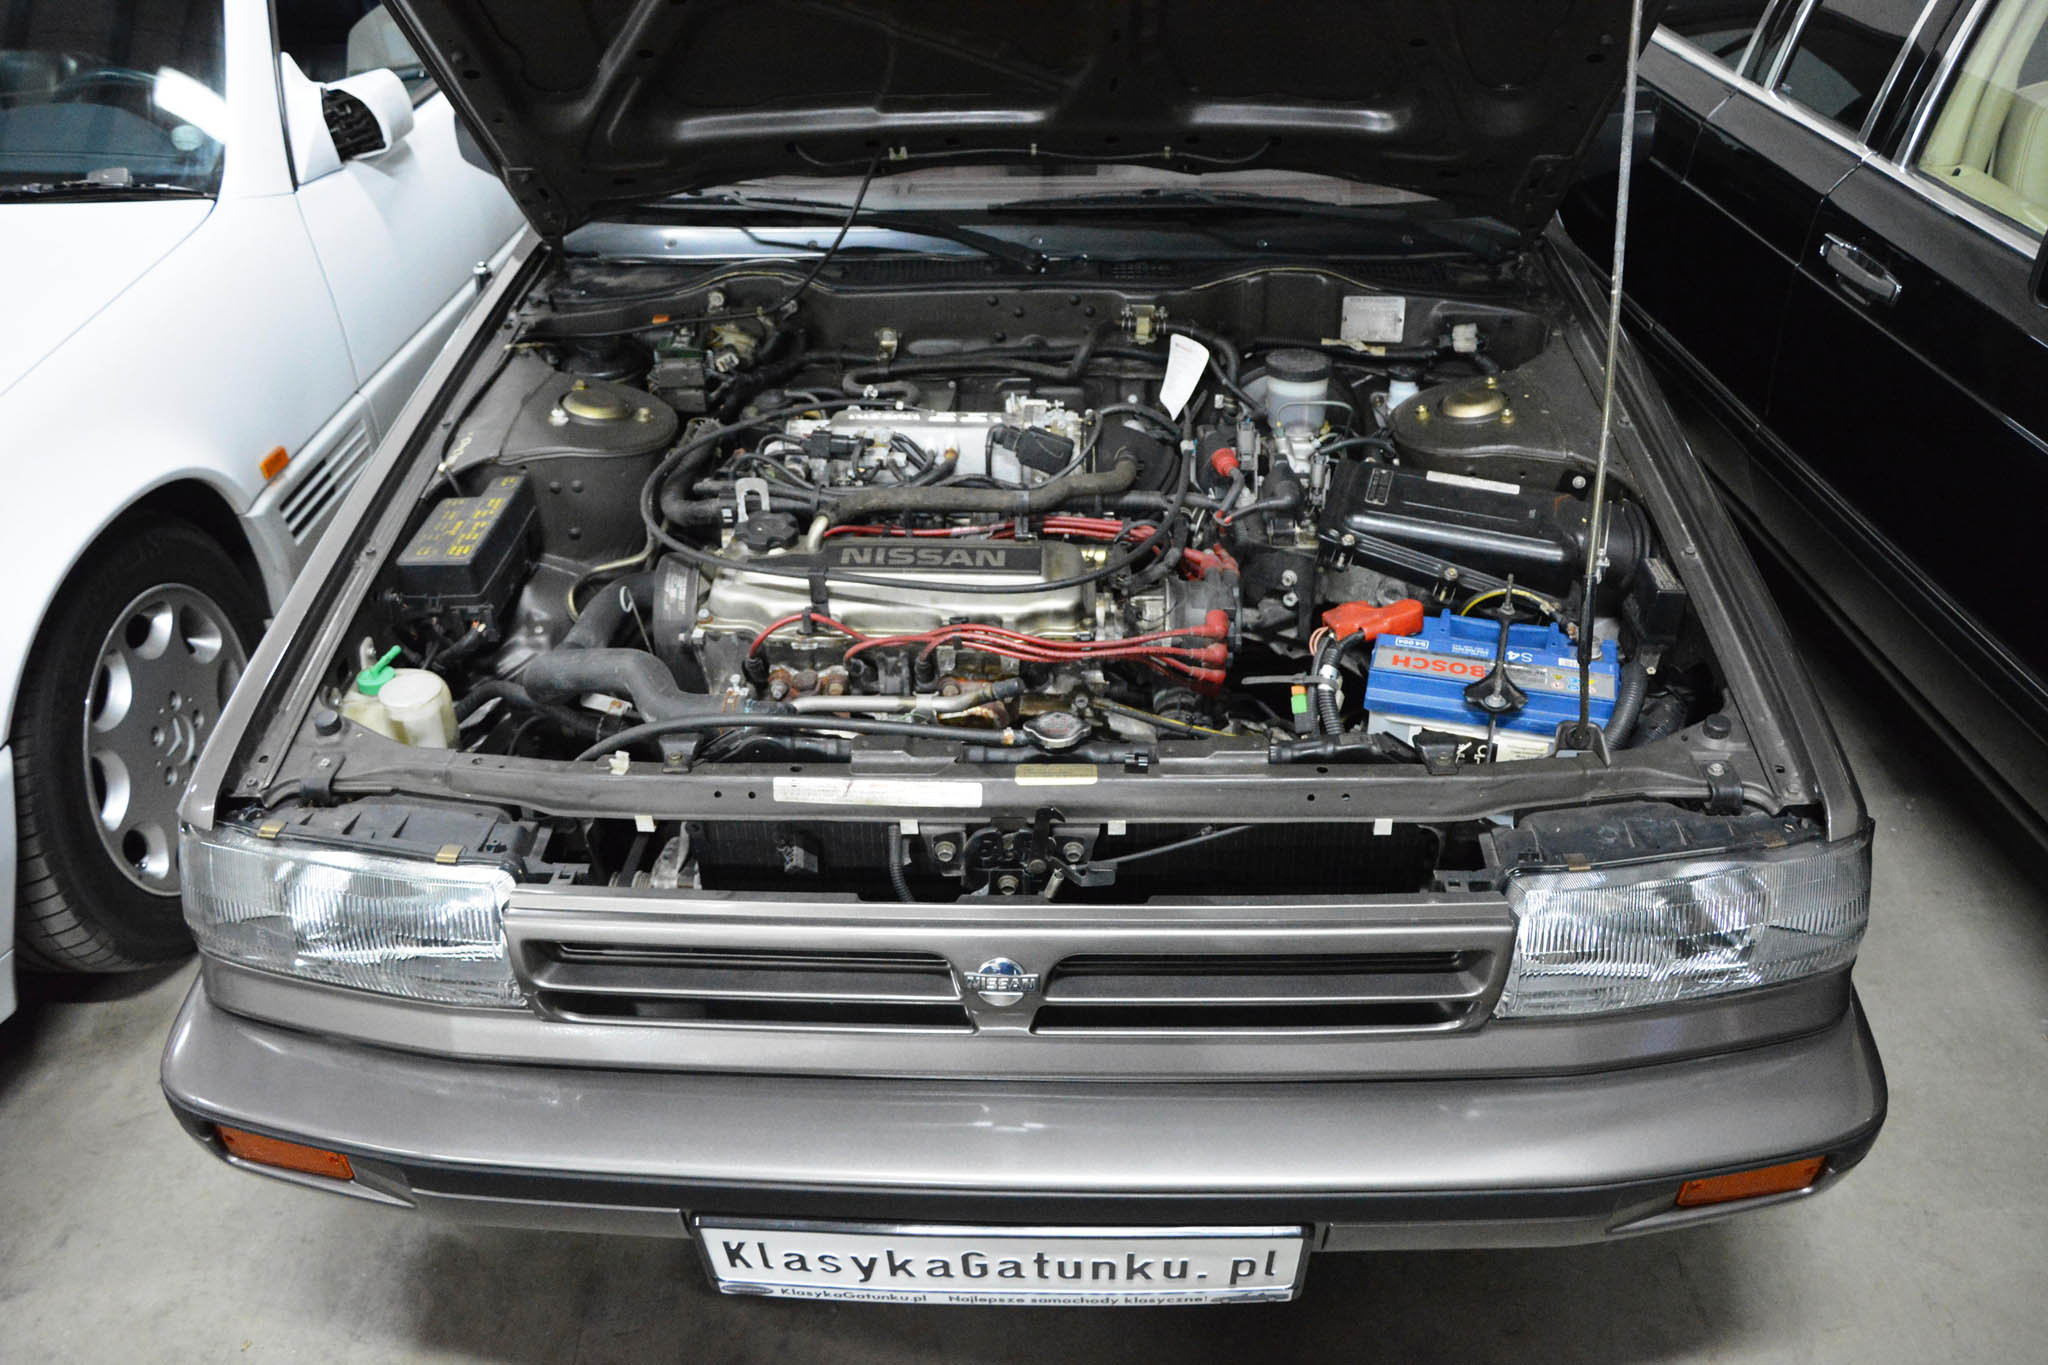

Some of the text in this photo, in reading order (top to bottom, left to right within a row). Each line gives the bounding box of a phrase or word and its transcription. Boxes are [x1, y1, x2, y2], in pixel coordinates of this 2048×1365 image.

[840, 547, 1006, 567] NISSAN
[1391, 654, 1486, 678] BOSCH
[1506, 651, 1534, 663] S4
[966, 975, 1036, 992] NISSAN
[780, 1287, 927, 1303] KlasykaGatunku.pl
[948, 1295, 1025, 1304] Najlepsze
[1030, 1297, 1119, 1305] samochody
